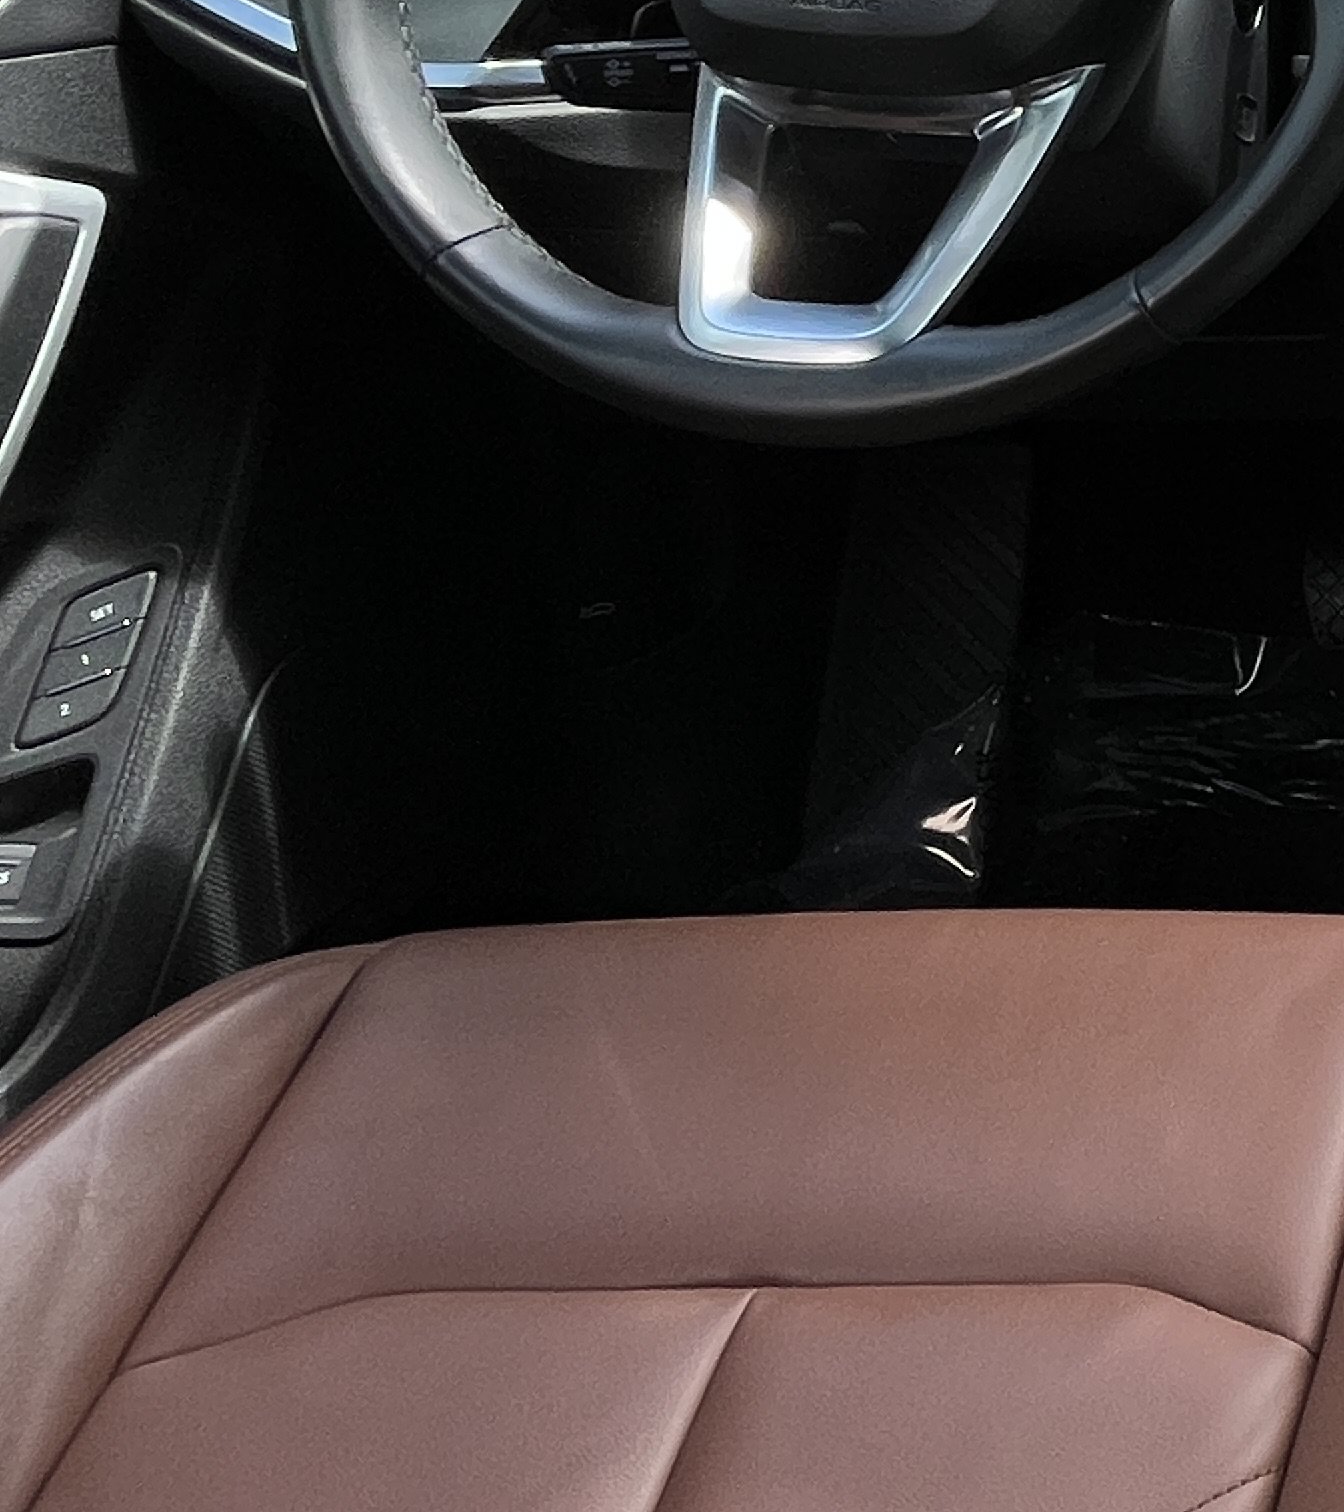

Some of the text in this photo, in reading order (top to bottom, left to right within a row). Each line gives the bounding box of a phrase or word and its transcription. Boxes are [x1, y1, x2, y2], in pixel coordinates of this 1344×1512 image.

[90, 602, 113, 622] SET
[81, 654, 90, 666] 1
[60, 703, 72, 717] 2
